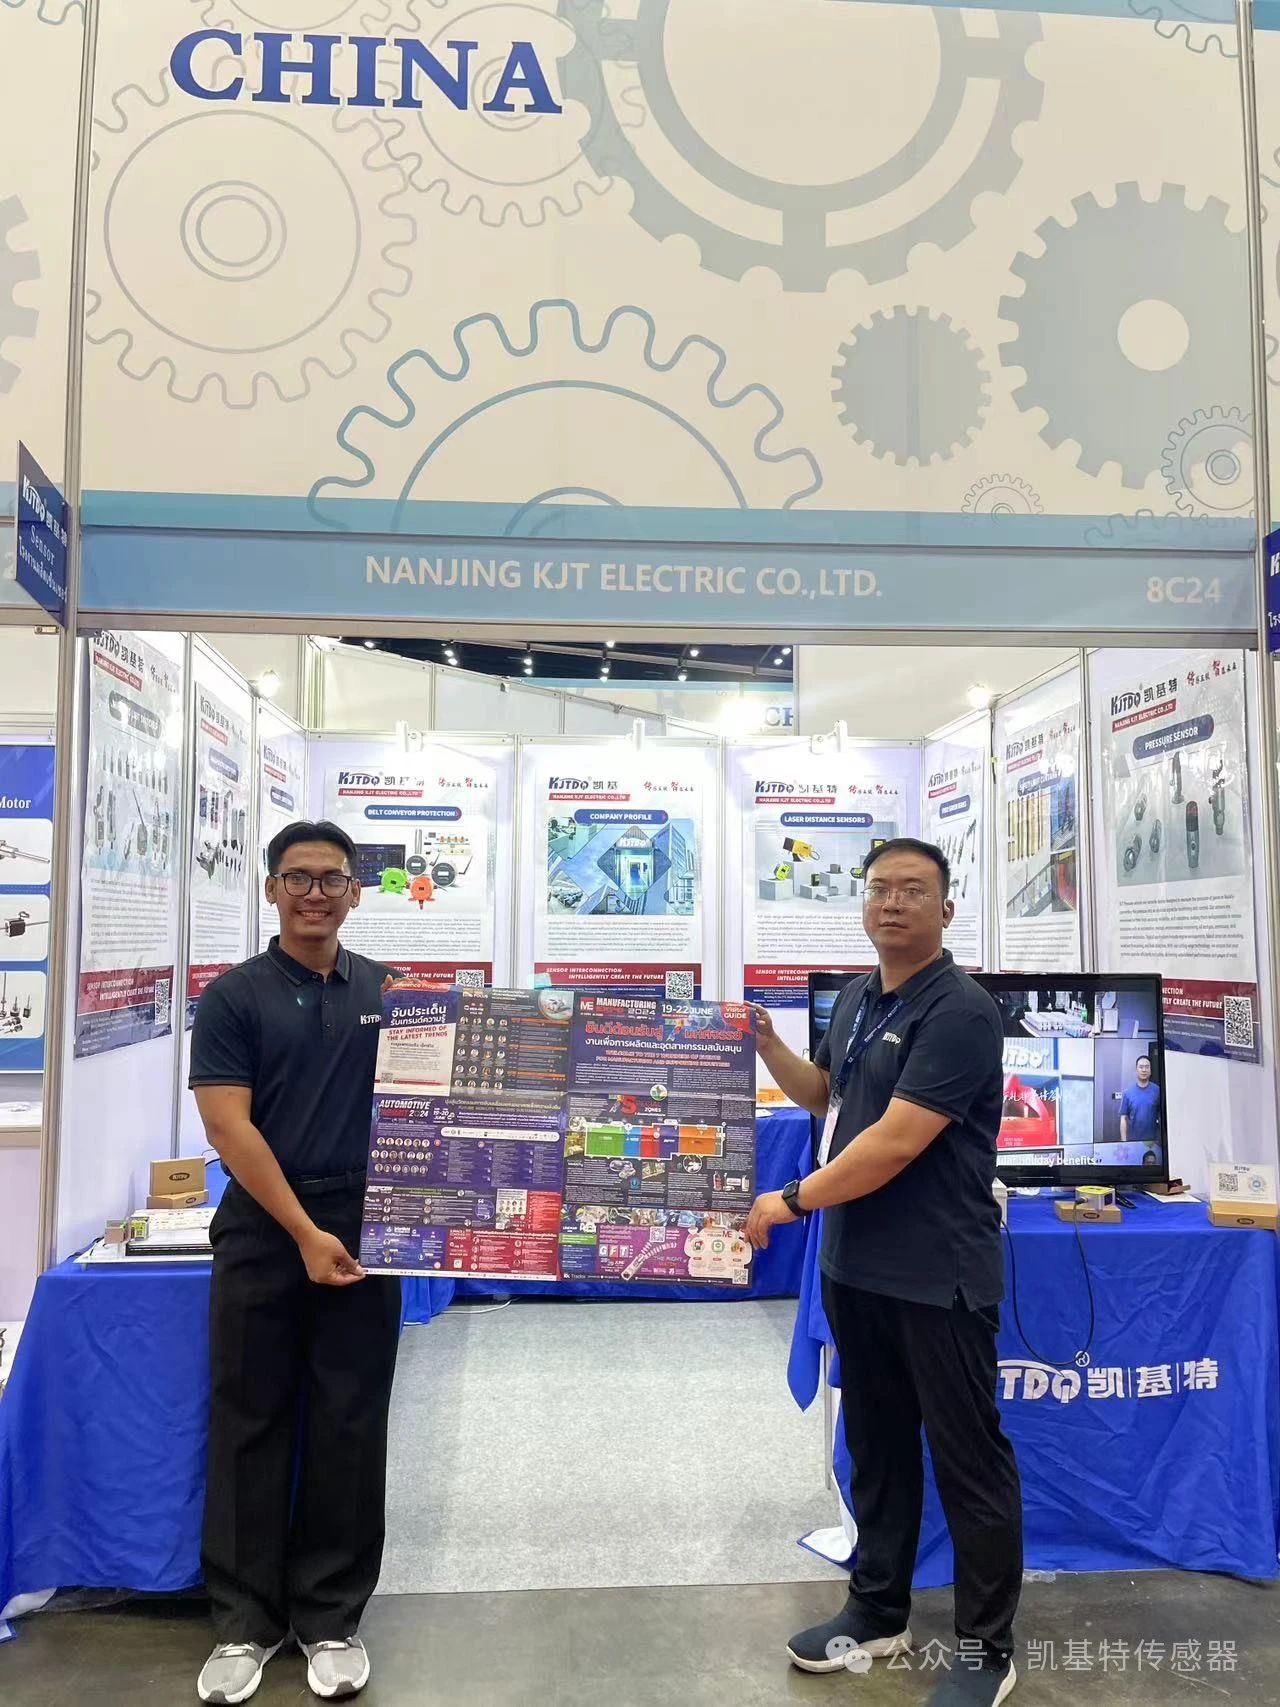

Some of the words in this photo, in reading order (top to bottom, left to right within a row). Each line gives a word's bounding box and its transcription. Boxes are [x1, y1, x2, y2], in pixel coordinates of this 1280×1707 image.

[170, 28, 563, 114] CHINA
[31, 525, 55, 565] Sensor
[365, 556, 522, 588] NANJING
[534, 561, 590, 590] KJT
[600, 563, 746, 595] ELECTRIC
[756, 568, 883, 600] CO.,LTD.
[1146, 576, 1224, 604] 8C24
[1144, 677, 1178, 703] 凯基特
[1145, 734, 1173, 751] PRESSURE
[1173, 726, 1199, 742] SENSOR
[391, 1003, 447, 1018] จับประเด็น
[580, 1001, 594, 1011] ME
[596, 997, 657, 1010] MANUFACTURING
[662, 1004, 689, 1014] 19-22
[689, 1007, 714, 1015] JUNE
[1172, 998, 1191, 1007] CREATE
[1192, 1000, 1202, 1008] THE
[1203, 1001, 1223, 1009] FUTURE
[379, 1099, 431, 1110] AUTOMOTIVE
[1056, 1155, 1097, 1166] benefits
[722, 1230, 733, 1238] ME
